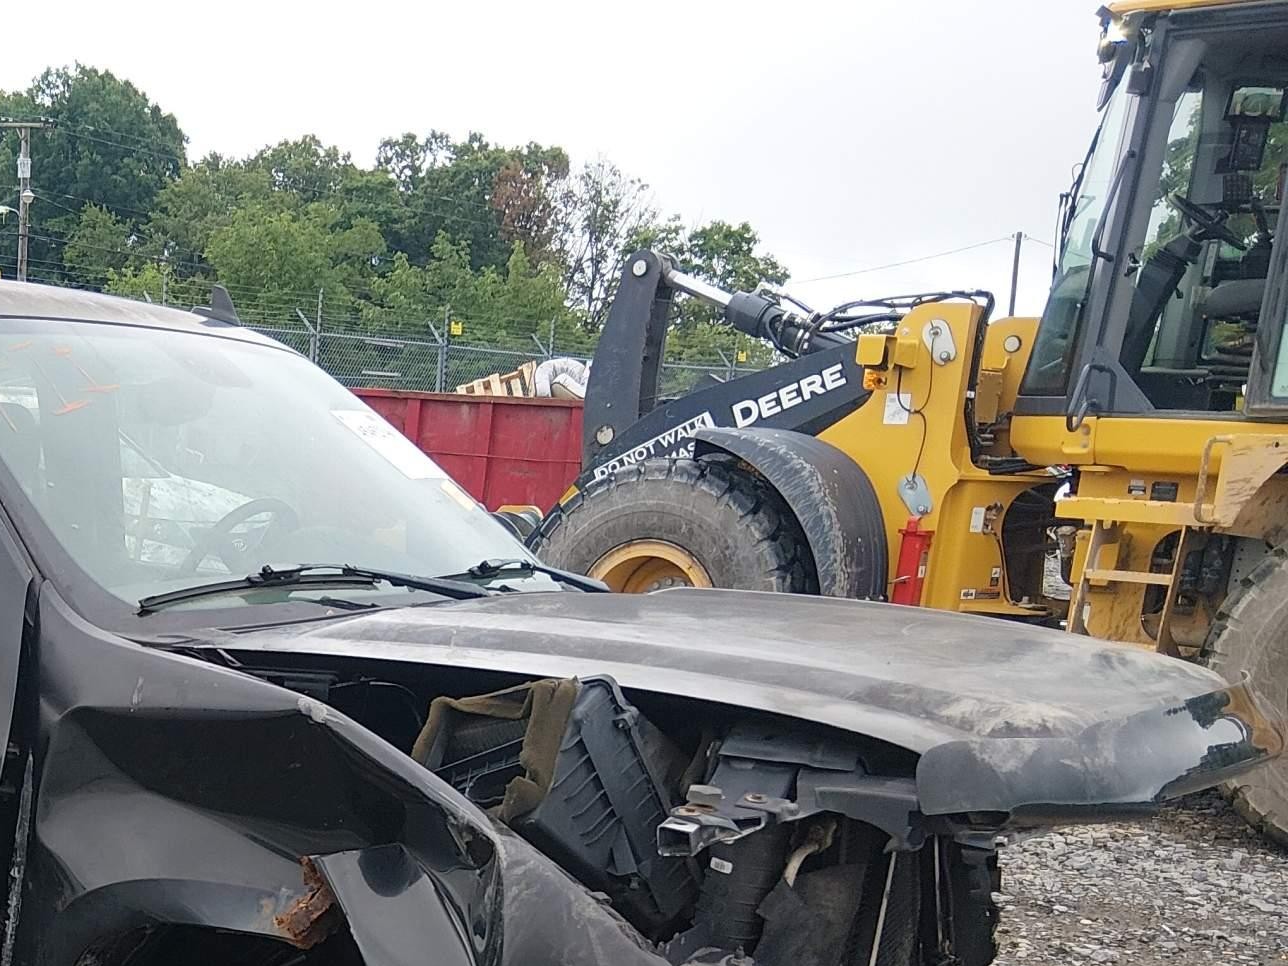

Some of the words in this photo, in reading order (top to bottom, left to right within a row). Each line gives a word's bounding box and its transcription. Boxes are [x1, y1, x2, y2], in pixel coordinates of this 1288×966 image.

[731, 362, 847, 429] DEERE
[596, 462, 620, 479] DO
[625, 441, 656, 466] NOT
[658, 416, 706, 448] WALK
